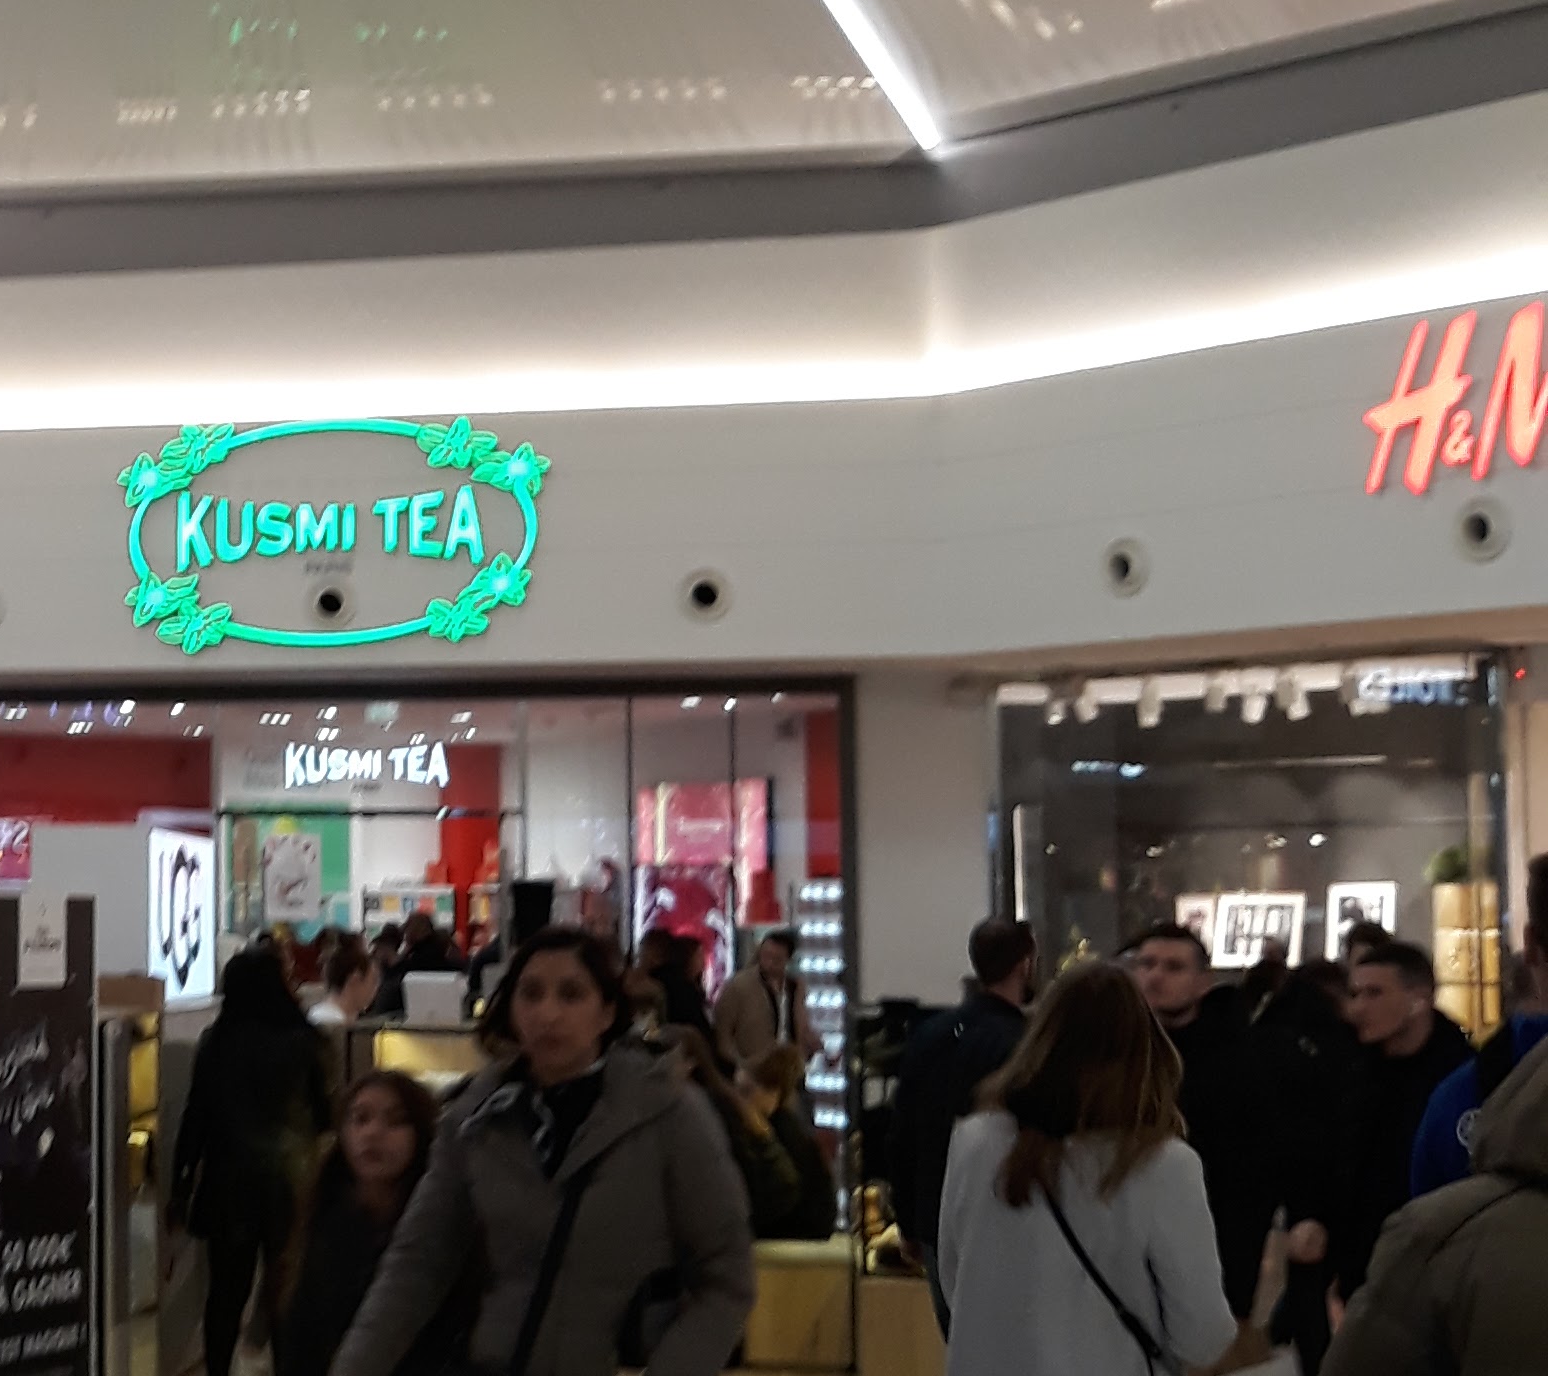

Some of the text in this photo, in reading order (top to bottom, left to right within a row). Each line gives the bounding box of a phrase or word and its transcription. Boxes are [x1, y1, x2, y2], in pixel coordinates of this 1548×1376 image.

[176, 483, 486, 573] KUSMI TEA
[284, 741, 451, 790] KUSMI TEA
[158, 845, 201, 995] UGG
